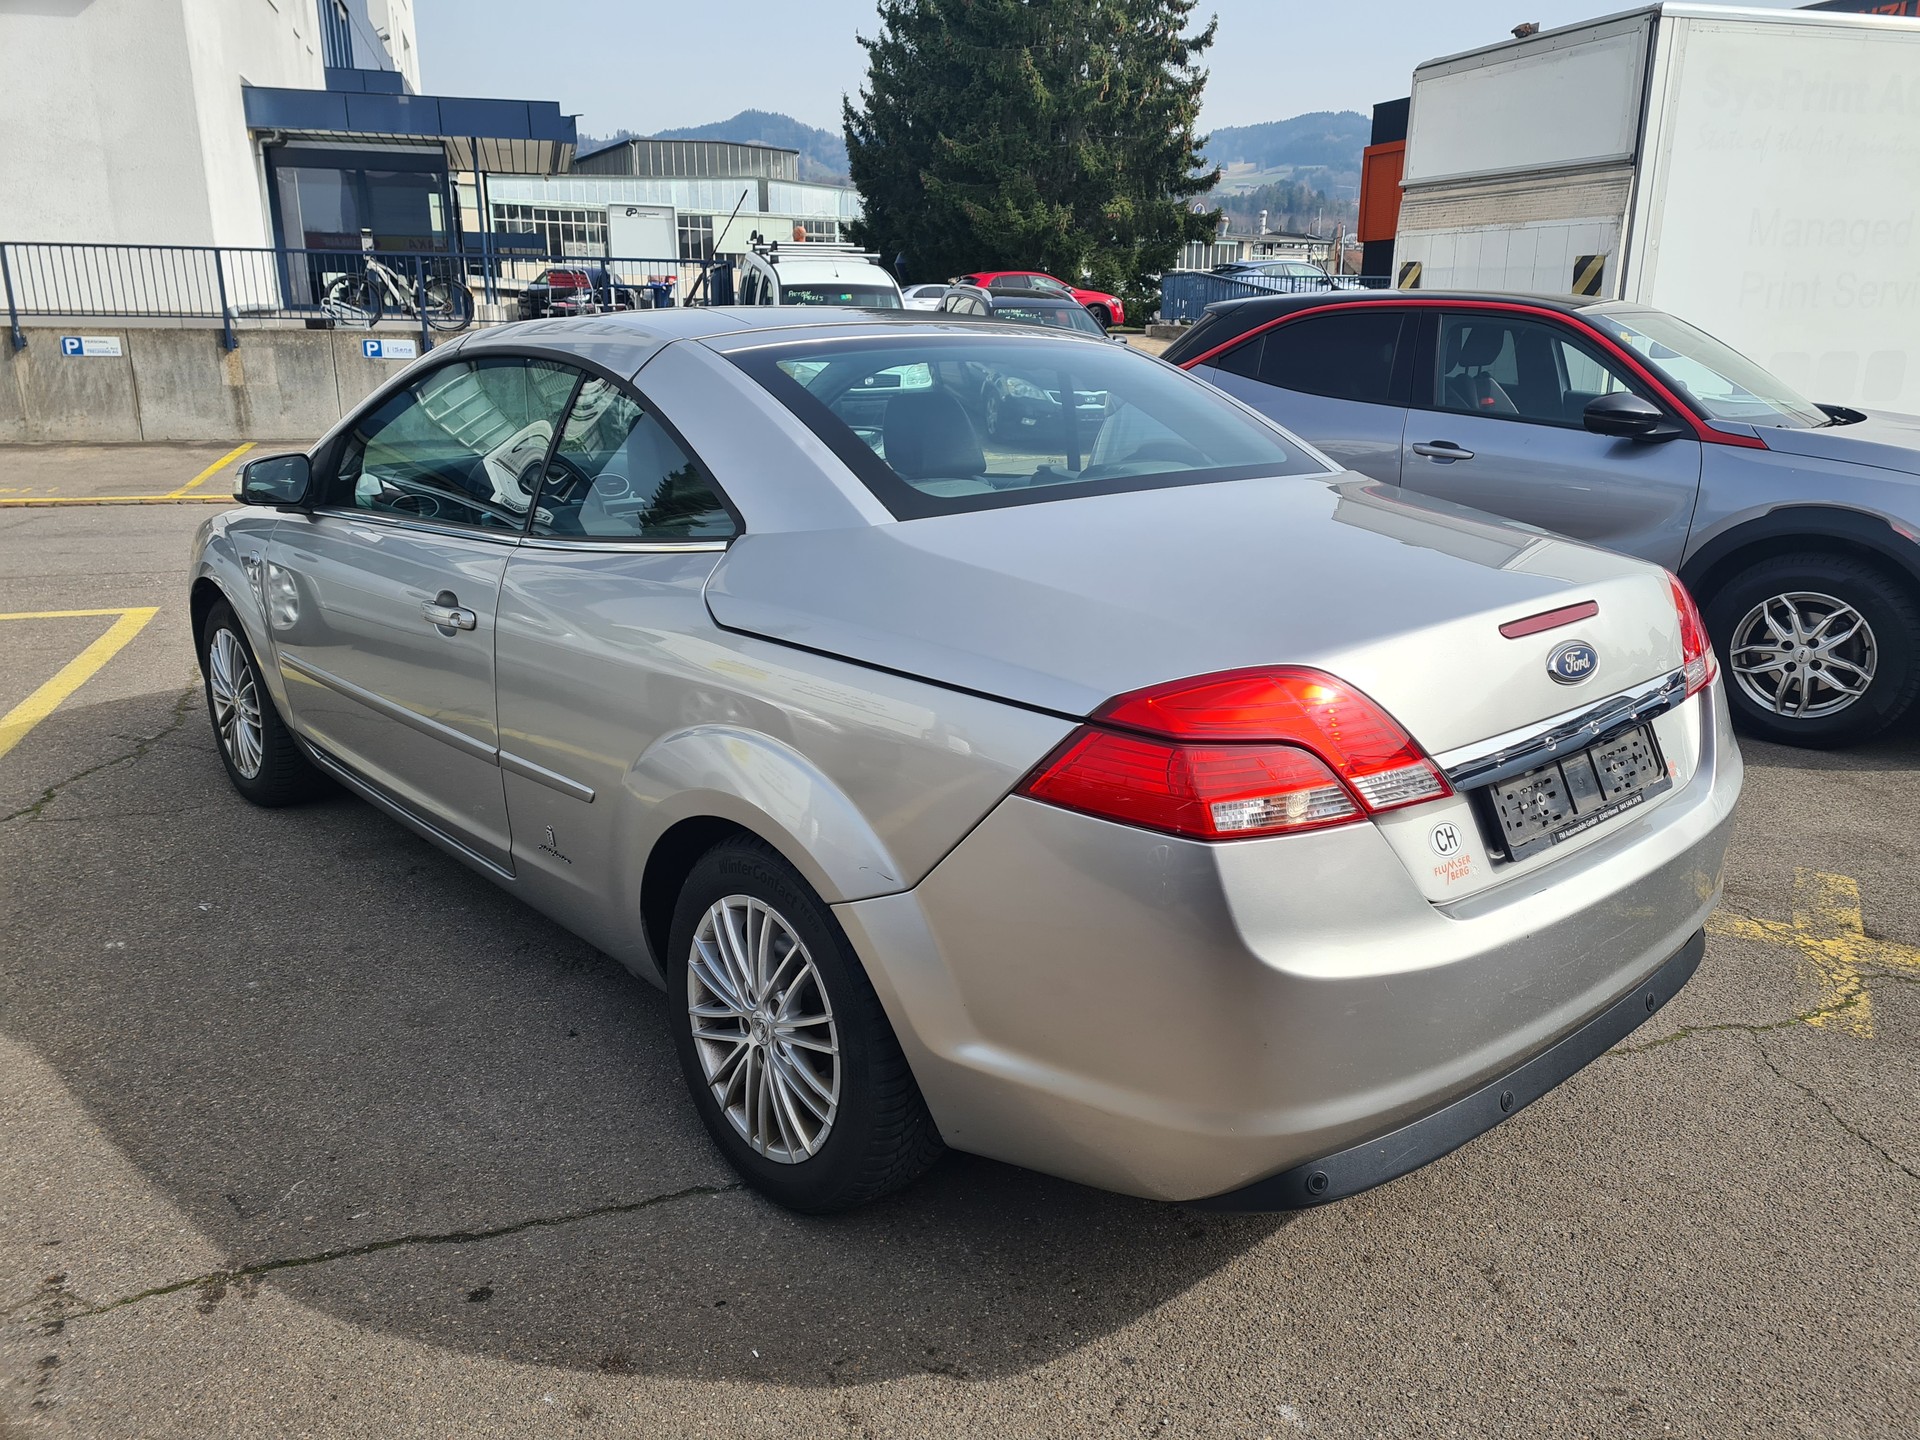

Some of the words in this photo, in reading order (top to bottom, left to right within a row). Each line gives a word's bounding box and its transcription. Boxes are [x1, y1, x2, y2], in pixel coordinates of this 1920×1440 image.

[1702, 66, 1870, 118] SysPrint
[1747, 207, 1916, 258] Managed
[1739, 270, 1822, 311] Print
[1565, 650, 1591, 673] Ford
[1435, 826, 1458, 852] CH
[719, 857, 797, 910] WinterContact
[1434, 854, 1472, 885] FLUMSER
[1450, 866, 1470, 881] BERG
